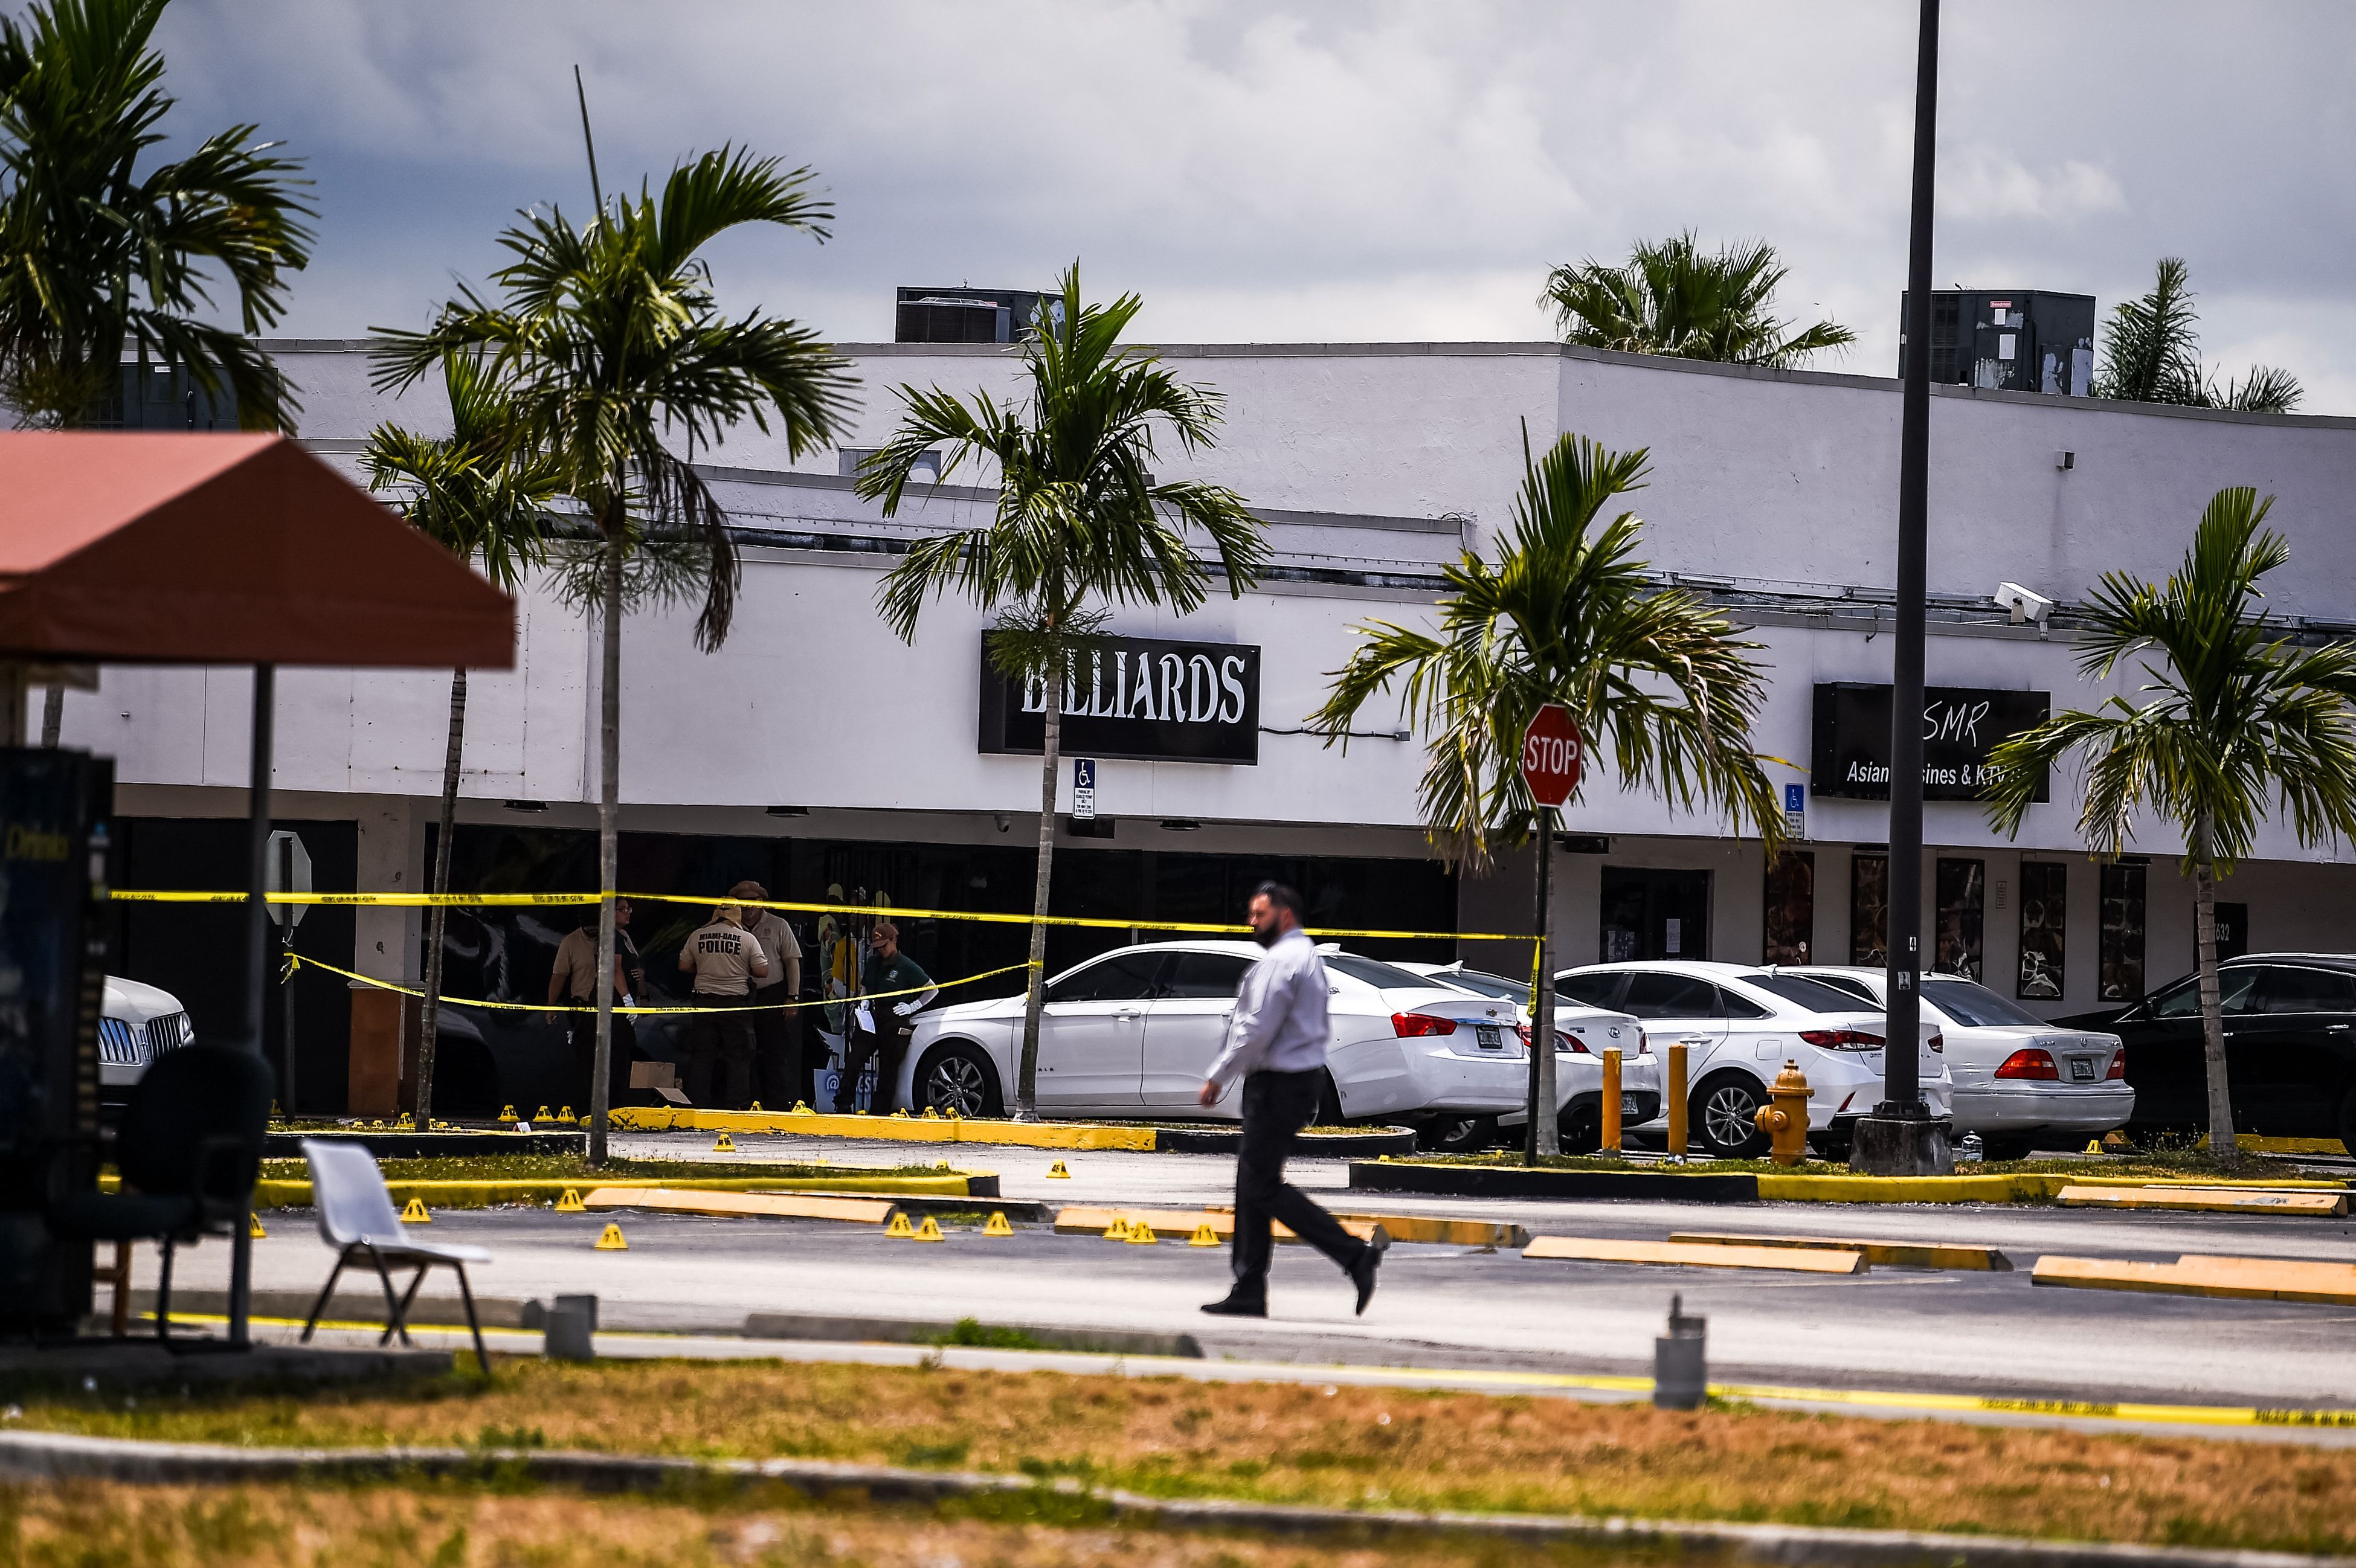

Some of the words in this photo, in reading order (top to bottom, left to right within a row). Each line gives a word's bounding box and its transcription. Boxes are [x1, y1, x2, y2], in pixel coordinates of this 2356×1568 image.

[1021, 647, 1246, 724] BLLIARDS
[1527, 734, 1579, 776] STOP
[1847, 760, 1889, 783] Asian
[1961, 764, 1971, 786] &
[699, 933, 741, 942] MIAMI-DADE
[2214, 923, 2230, 941] 632
[698, 940, 742, 956] POLICE
[1910, 937, 1916, 951] 4
